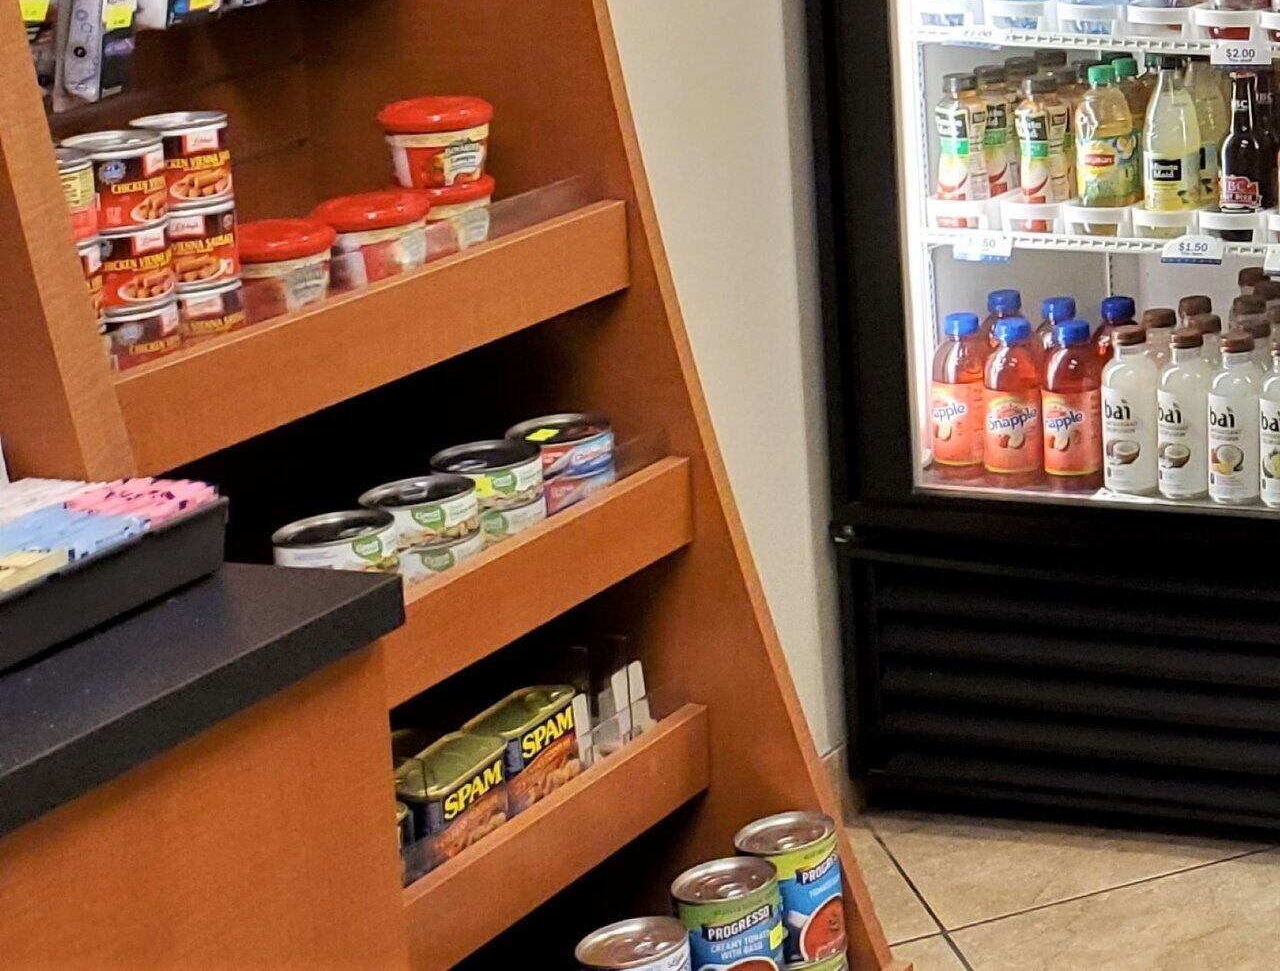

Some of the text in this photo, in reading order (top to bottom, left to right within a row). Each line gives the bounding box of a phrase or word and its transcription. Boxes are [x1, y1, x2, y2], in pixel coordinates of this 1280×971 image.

[1226, 46, 1256, 59] $2.00
[1178, 242, 1208, 252] $1.50
[988, 407, 1037, 430] Snapple
[1045, 409, 1083, 431] napple
[1105, 399, 1131, 420] bai
[1158, 402, 1182, 424] bai
[1209, 406, 1236, 428] bai
[522, 706, 574, 758] SPAM
[444, 759, 502, 819] SPAM
[708, 905, 770, 941] PROGRESSO
